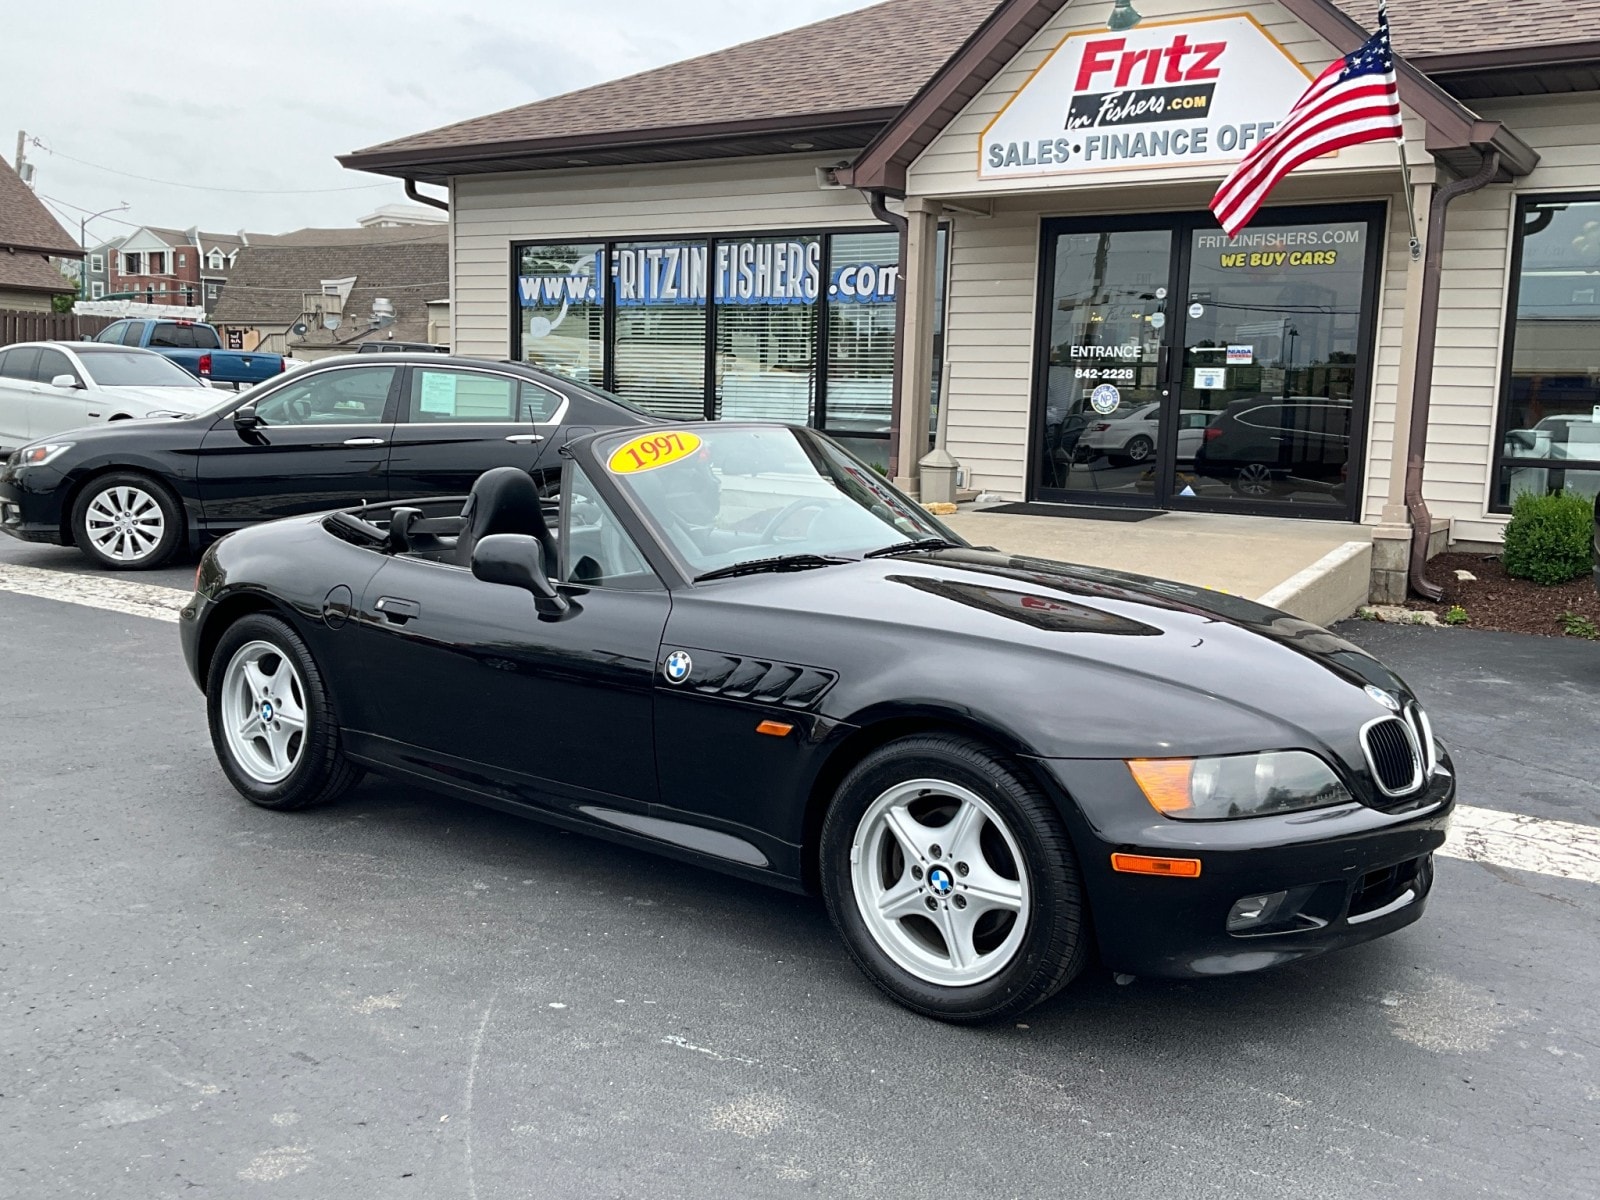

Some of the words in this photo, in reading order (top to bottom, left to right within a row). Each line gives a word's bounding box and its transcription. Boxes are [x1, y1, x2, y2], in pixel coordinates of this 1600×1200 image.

[1074, 35, 1227, 91] Fritz
[1067, 108, 1092, 130] in
[1198, 230, 1359, 248] FRITZINFISHERS.COM
[1220, 253, 1247, 268] WE
[1249, 252, 1287, 267] BUY
[1289, 250, 1337, 266] CARS
[1070, 345, 1142, 358] ENTRANCE
[1074, 368, 1134, 379] 842-2228
[626, 433, 684, 469] 1997
